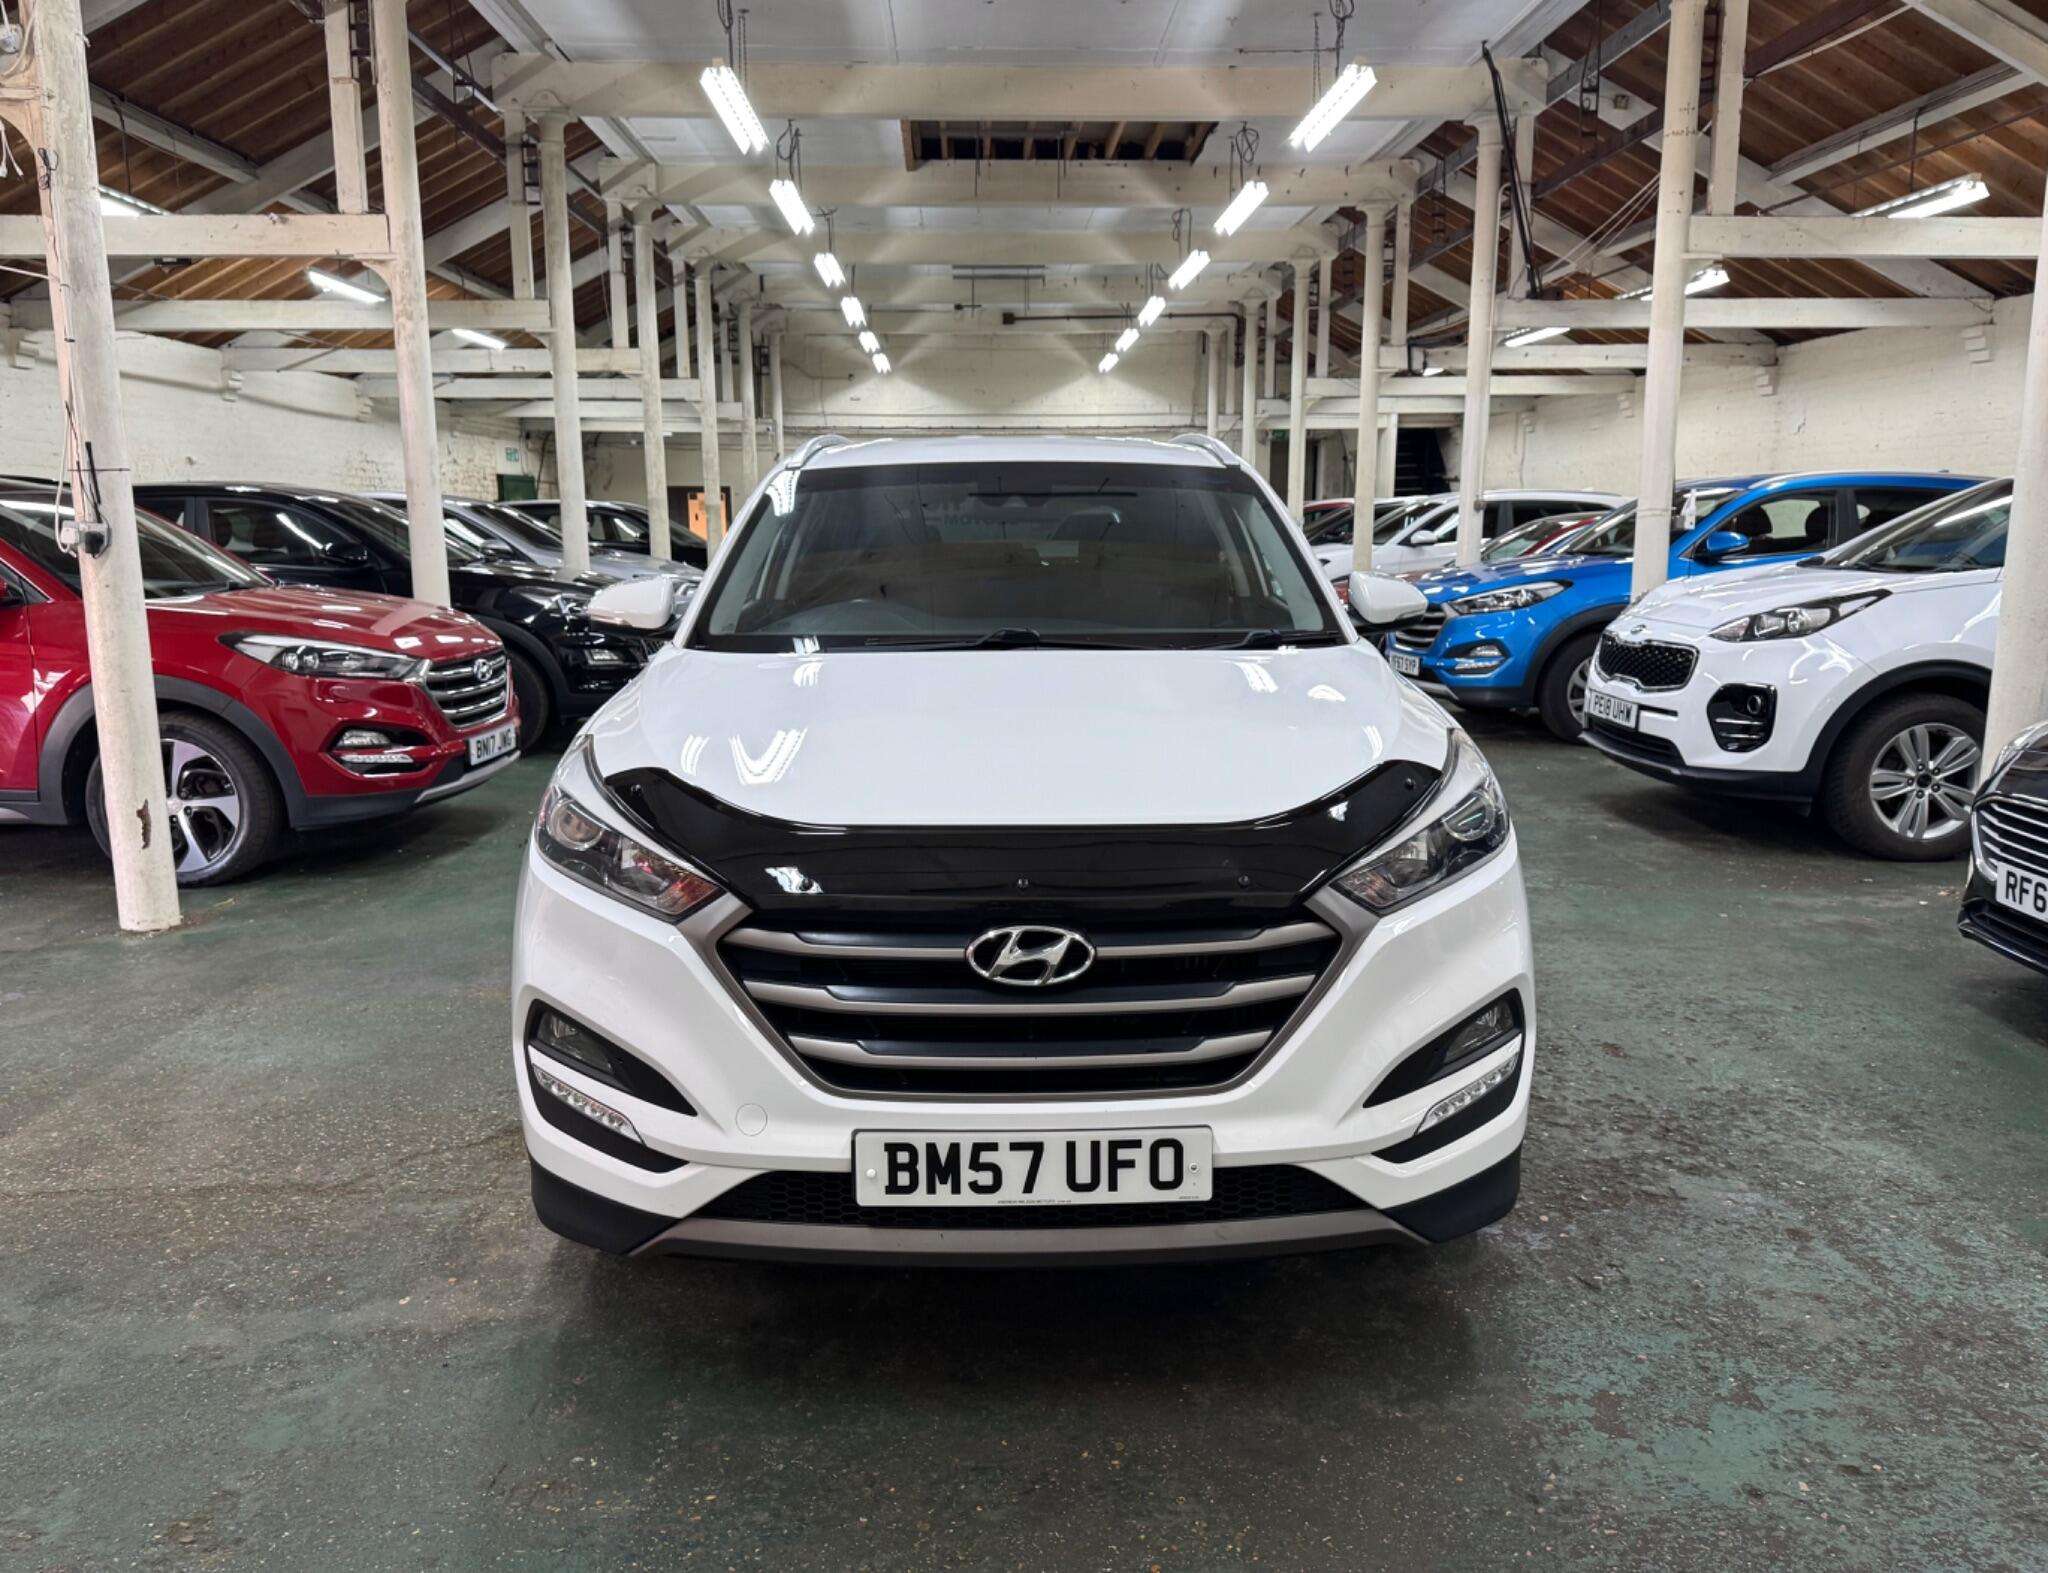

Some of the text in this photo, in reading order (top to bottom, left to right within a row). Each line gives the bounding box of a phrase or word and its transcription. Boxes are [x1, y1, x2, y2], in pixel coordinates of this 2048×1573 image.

[1593, 694, 1632, 722] PE18 UHW
[476, 734, 496, 759] BN17
[2005, 870, 2048, 913] RF6
[884, 1138, 1184, 1195] BM57 UFO
